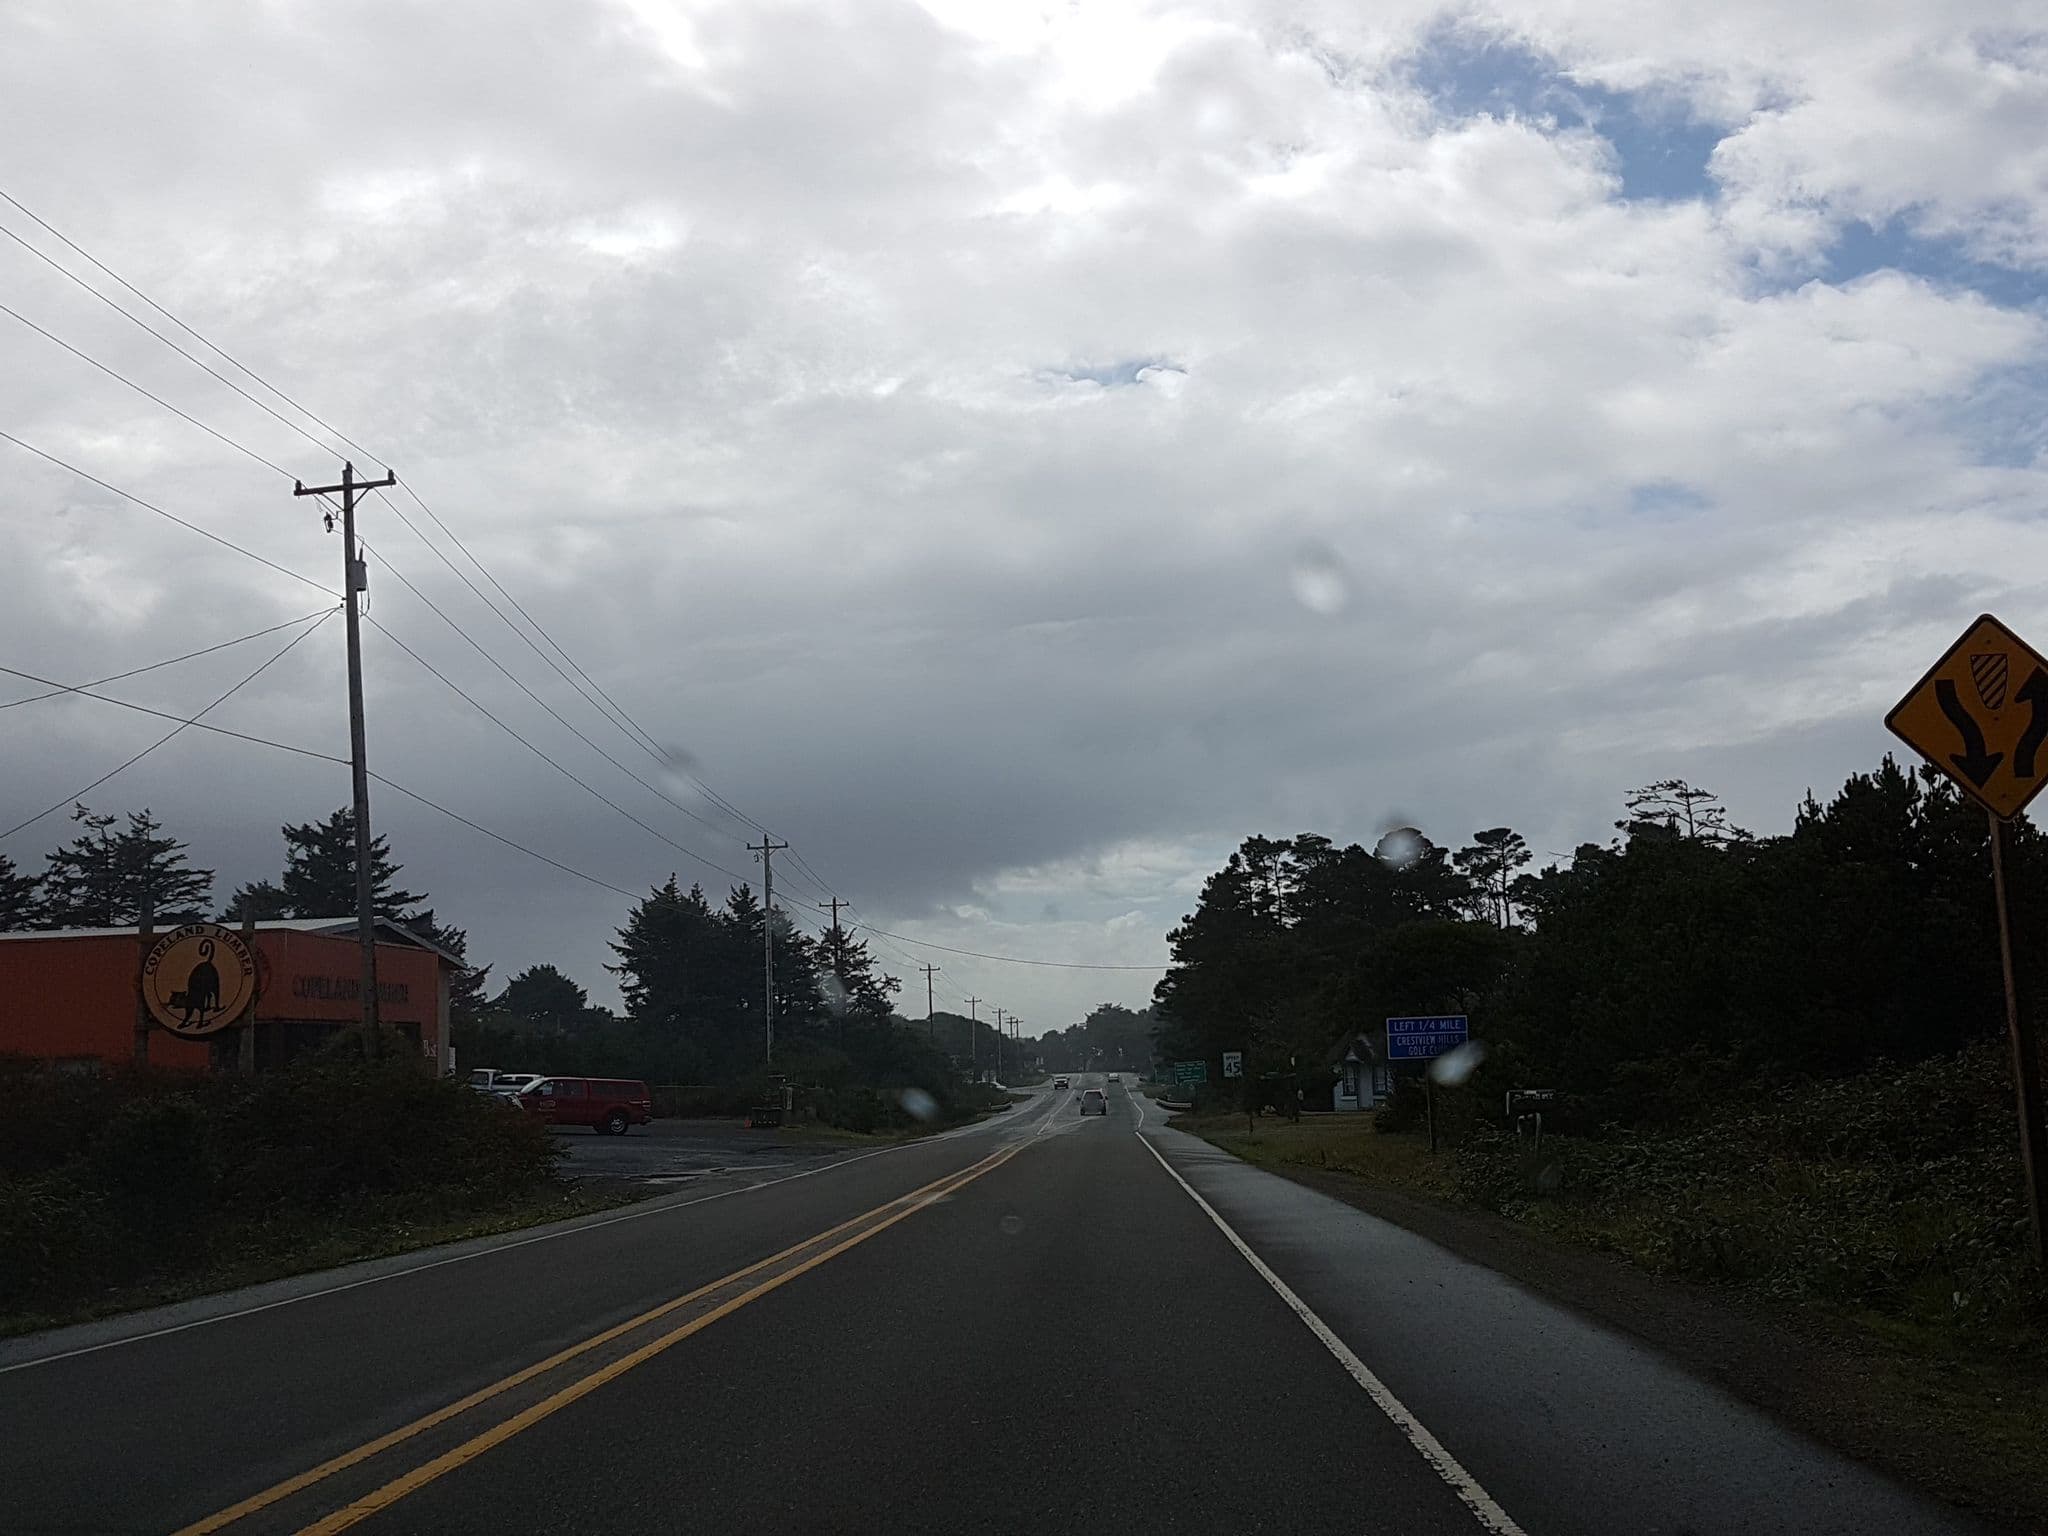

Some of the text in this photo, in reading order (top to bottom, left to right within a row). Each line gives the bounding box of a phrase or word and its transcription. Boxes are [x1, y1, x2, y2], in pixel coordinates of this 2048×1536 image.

[145, 925, 204, 976] COPELAND
[215, 928, 253, 977] LUMBER
[1393, 1018, 1462, 1032] LEFT 1/4 MILE
[1396, 1034, 1460, 1046] CRESTVIEW HILLS
[1408, 1046, 1426, 1056] GOLF
[1225, 1061, 1241, 1073] 45
